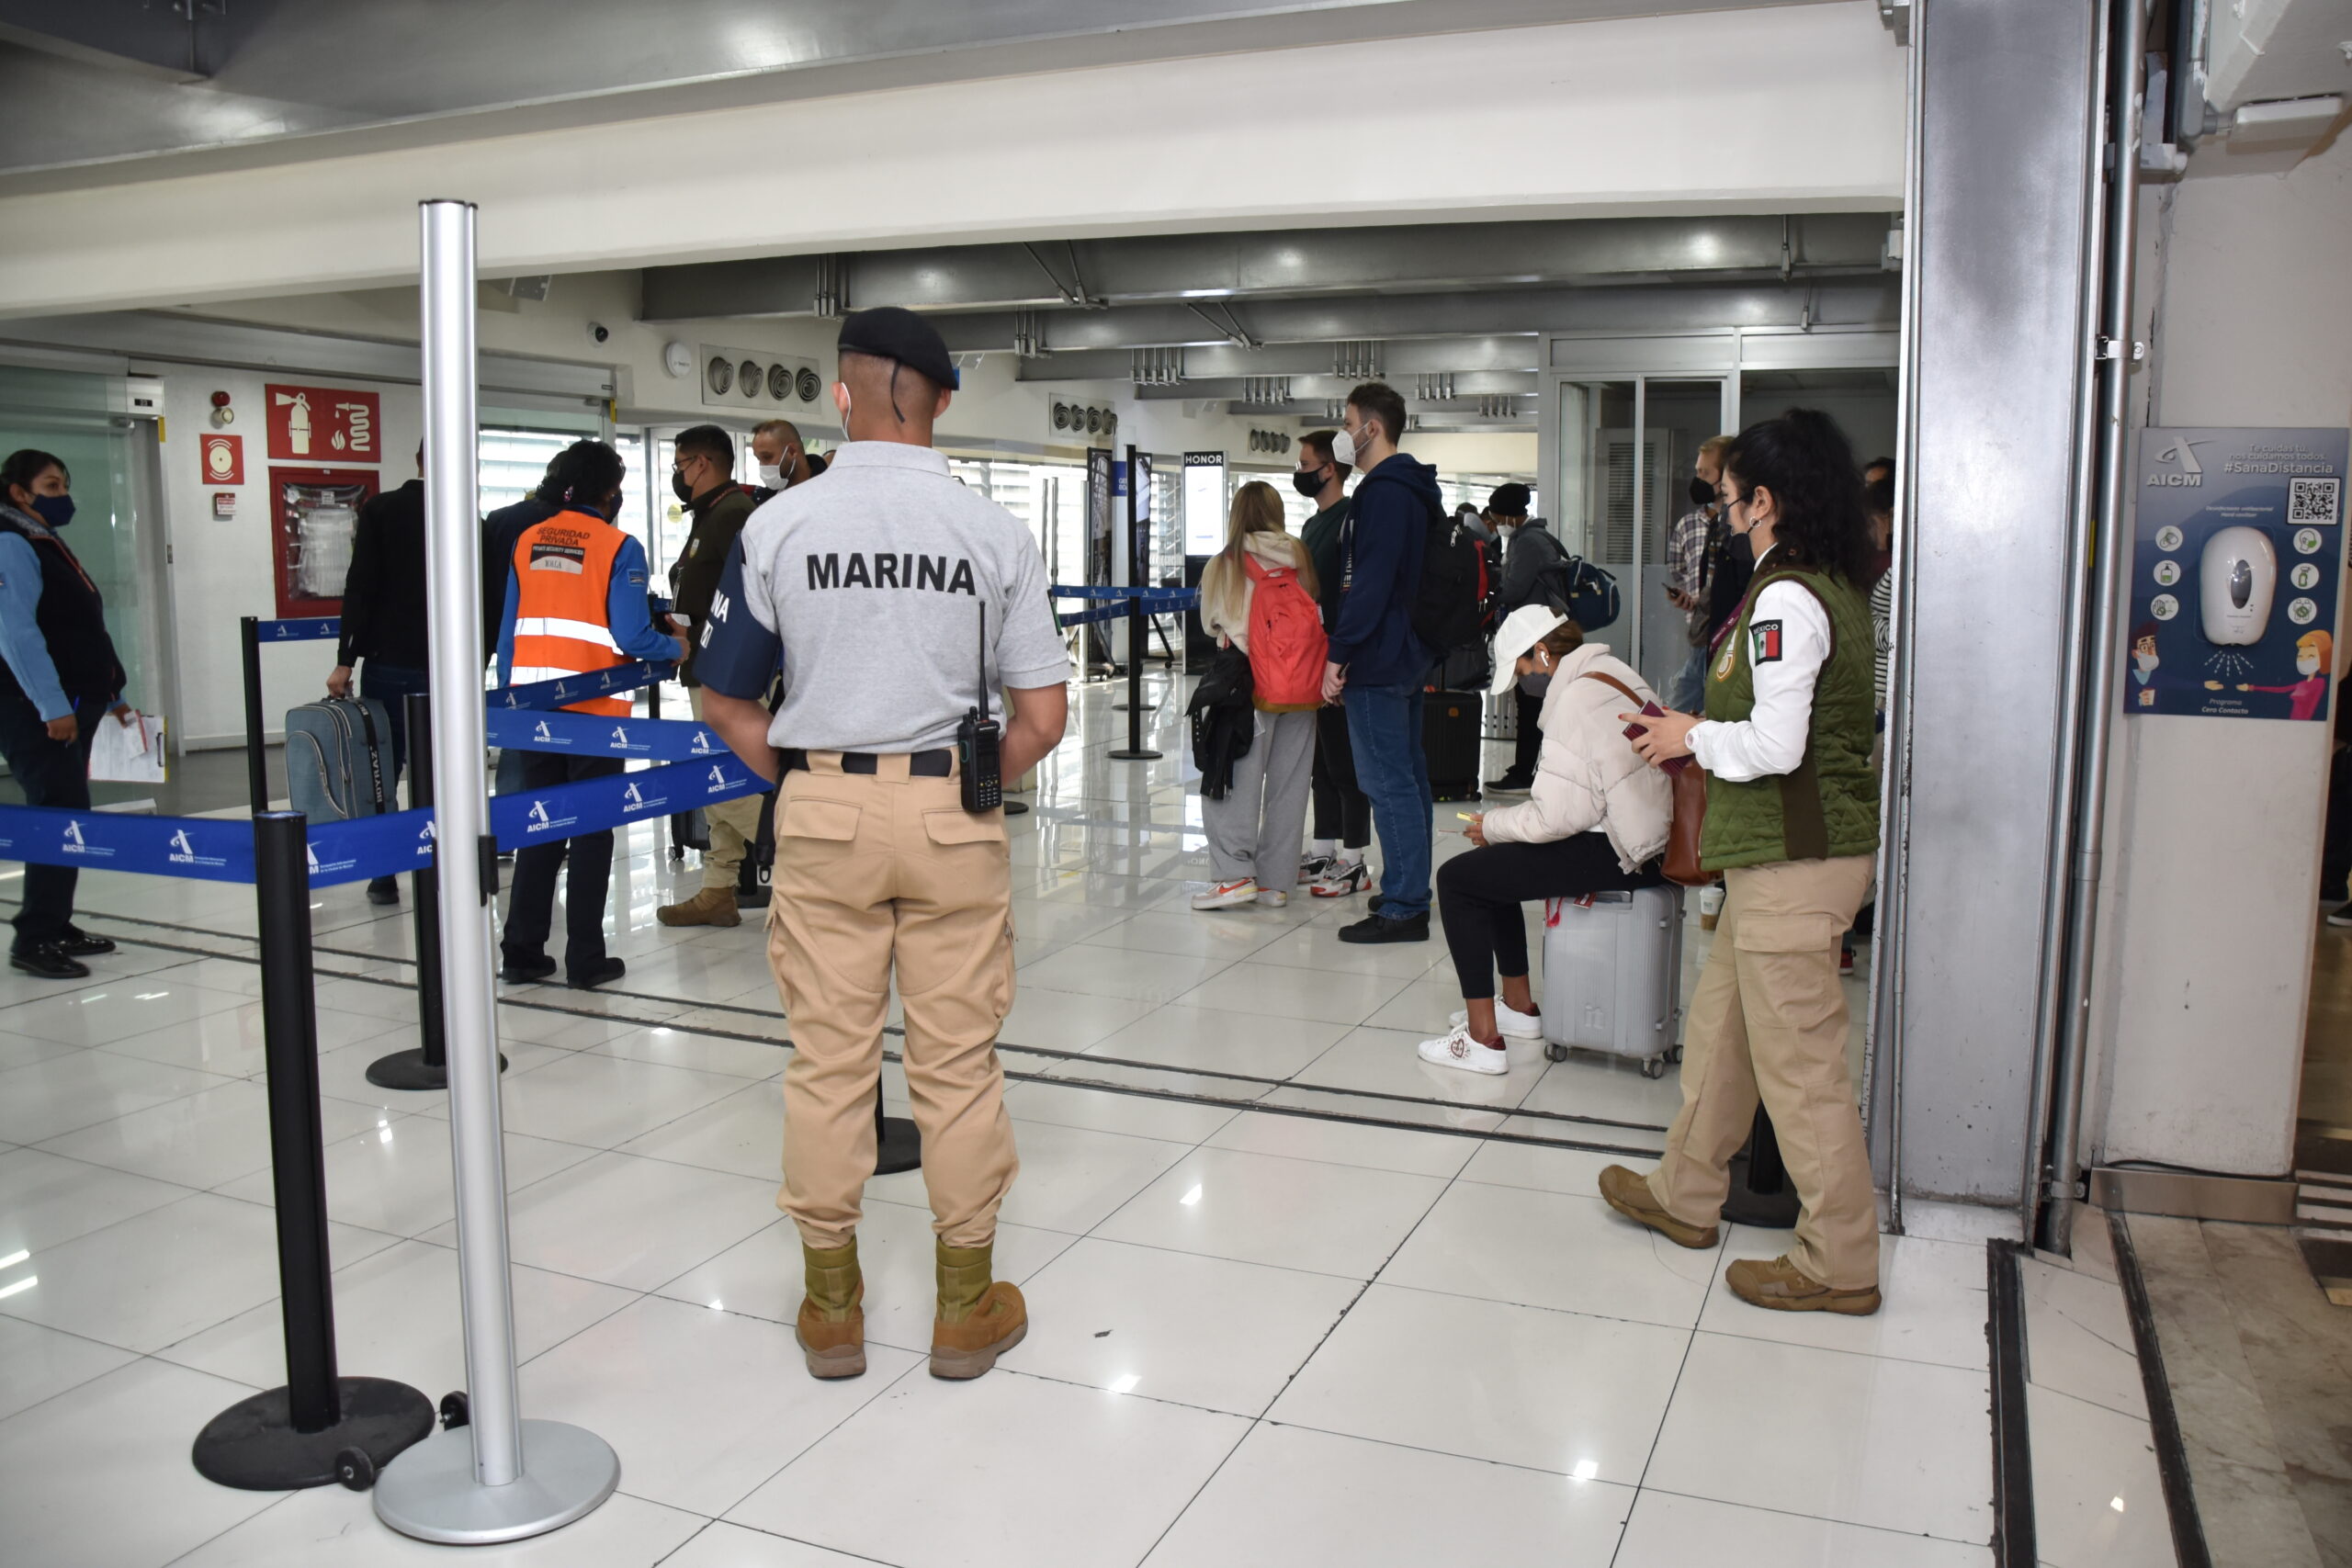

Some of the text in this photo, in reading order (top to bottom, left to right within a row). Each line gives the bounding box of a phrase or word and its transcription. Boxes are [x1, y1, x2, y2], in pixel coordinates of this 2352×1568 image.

[1185, 455, 1223, 465] HONOR
[2223, 462, 2334, 474] #SanaDistancia
[2146, 473, 2203, 487] AICM
[537, 526, 591, 539] SEGURIDAD
[539, 535, 579, 546] PRIVADA
[806, 552, 977, 596] MARINA
[526, 821, 550, 832] AICM
[416, 844, 433, 855] AIC
[169, 852, 195, 863] AICM
